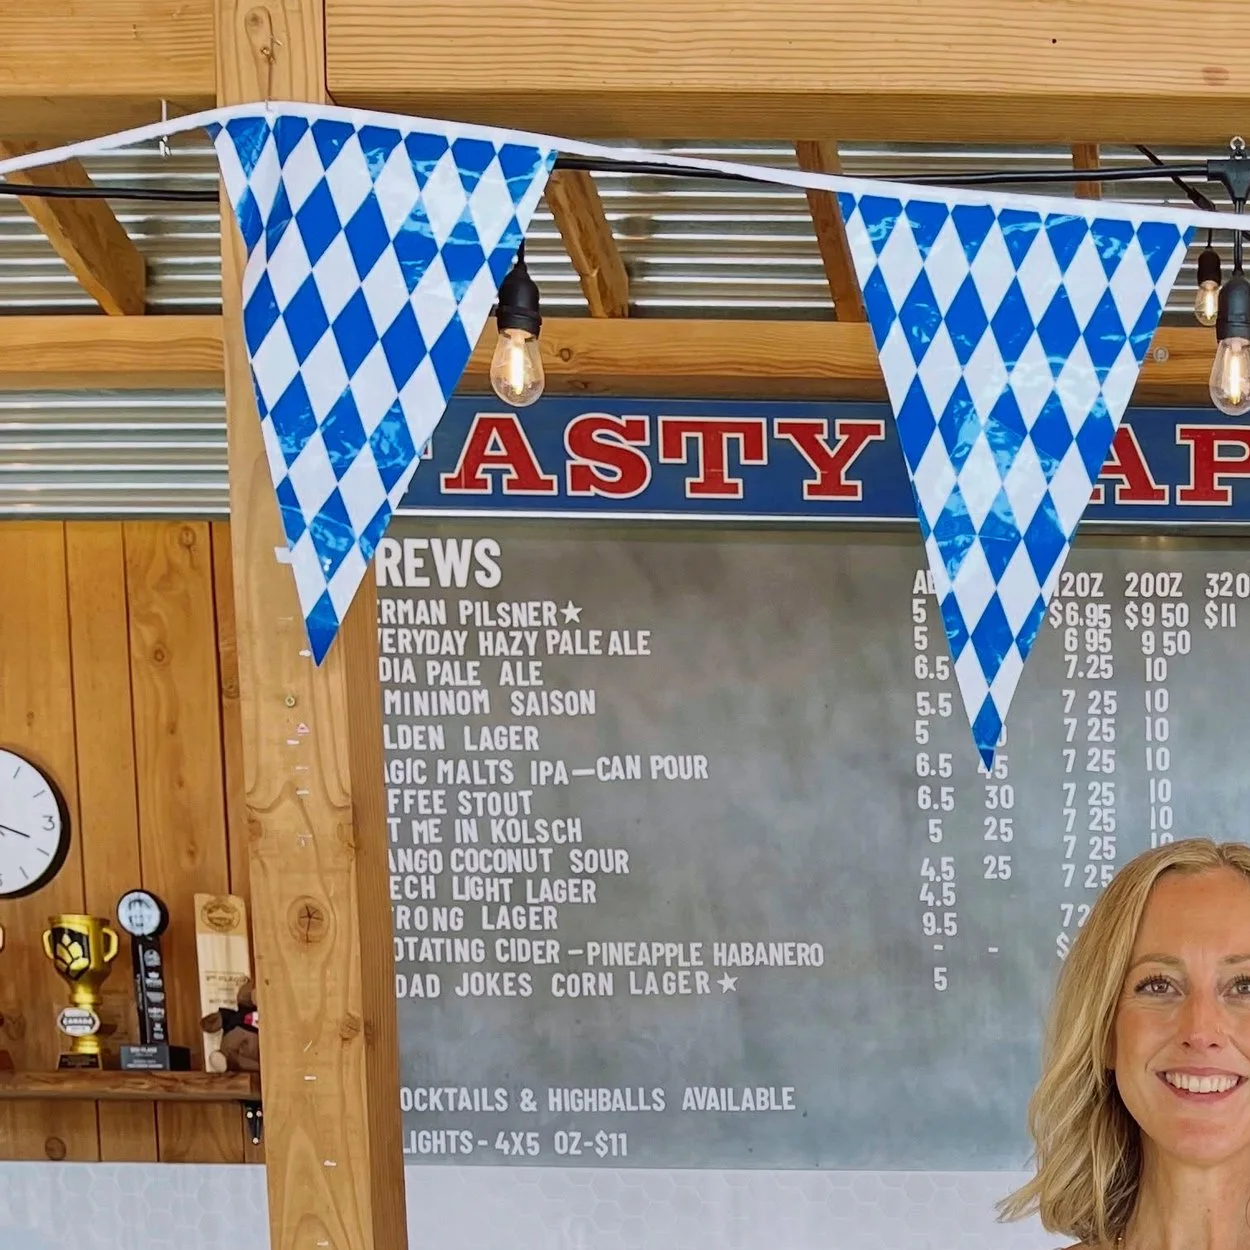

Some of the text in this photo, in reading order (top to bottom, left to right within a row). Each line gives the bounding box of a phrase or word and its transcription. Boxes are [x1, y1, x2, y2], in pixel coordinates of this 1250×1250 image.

[440, 411, 885, 501] ASTY
[375, 538, 501, 588] REWS
[1125, 572, 1182, 597] 20OZ
[376, 599, 557, 627] RMAN PILSNER
[913, 598, 926, 623] 5
[1050, 600, 1111, 628] $6.95
[1205, 600, 1236, 629] $11
[378, 628, 651, 656] ERYDAY HAZY PALE ALE
[914, 626, 928, 650] 5
[1065, 628, 1111, 653] 6 95
[1142, 630, 1190, 655] 9 50
[379, 657, 543, 686] DIA PALE ALE
[915, 654, 949, 680] 6.5
[1065, 654, 1113, 679] 7.25
[1146, 657, 1167, 681] 10
[384, 689, 595, 716] MININOM SAISON
[917, 692, 952, 717] 5.5
[1063, 689, 1117, 714] 7 25
[1146, 688, 1168, 712] 10
[383, 724, 539, 751] LDEN LAGER
[916, 720, 929, 744] 5
[1064, 717, 1115, 742] 7 25
[1145, 716, 1169, 741] 10
[384, 758, 427, 784] GIC
[437, 759, 514, 784] MALTS
[650, 755, 708, 780] POUR
[917, 752, 952, 777] 6.5
[1146, 747, 1170, 771] 10
[388, 789, 533, 817] FFEE STOUT
[918, 785, 954, 811] 6.5
[985, 785, 1014, 809] 30
[1150, 778, 1171, 803] 10
[43, 815, 55, 832] 3
[984, 816, 1013, 842] 25
[1151, 806, 1172, 829] 10
[412, 818, 442, 844] ME
[455, 819, 478, 843] IN
[491, 818, 582, 844] KOLSCH
[929, 819, 942, 843] 5
[1064, 835, 1116, 860] 7 25
[388, 848, 629, 874] NGO COCONUT SOUR
[920, 857, 954, 882] 4.5
[984, 855, 1011, 879] 25
[390, 875, 596, 903] ECH LIGHT LAGER
[920, 882, 955, 906] 4.5
[391, 905, 557, 931] RONG LAGER
[923, 912, 957, 936] 9.5
[394, 936, 485, 962] OTATING
[495, 938, 560, 964] CIDER
[713, 942, 823, 966] HABANERO
[396, 971, 710, 998] DAD JOKES CORN LAGER
[934, 967, 947, 991] 5
[400, 1087, 795, 1112] OCKTAILS & HIGHBALLS AVAILABLE
[495, 1132, 539, 1155] 4X5
[555, 1130, 627, 1157] OZ-$11
